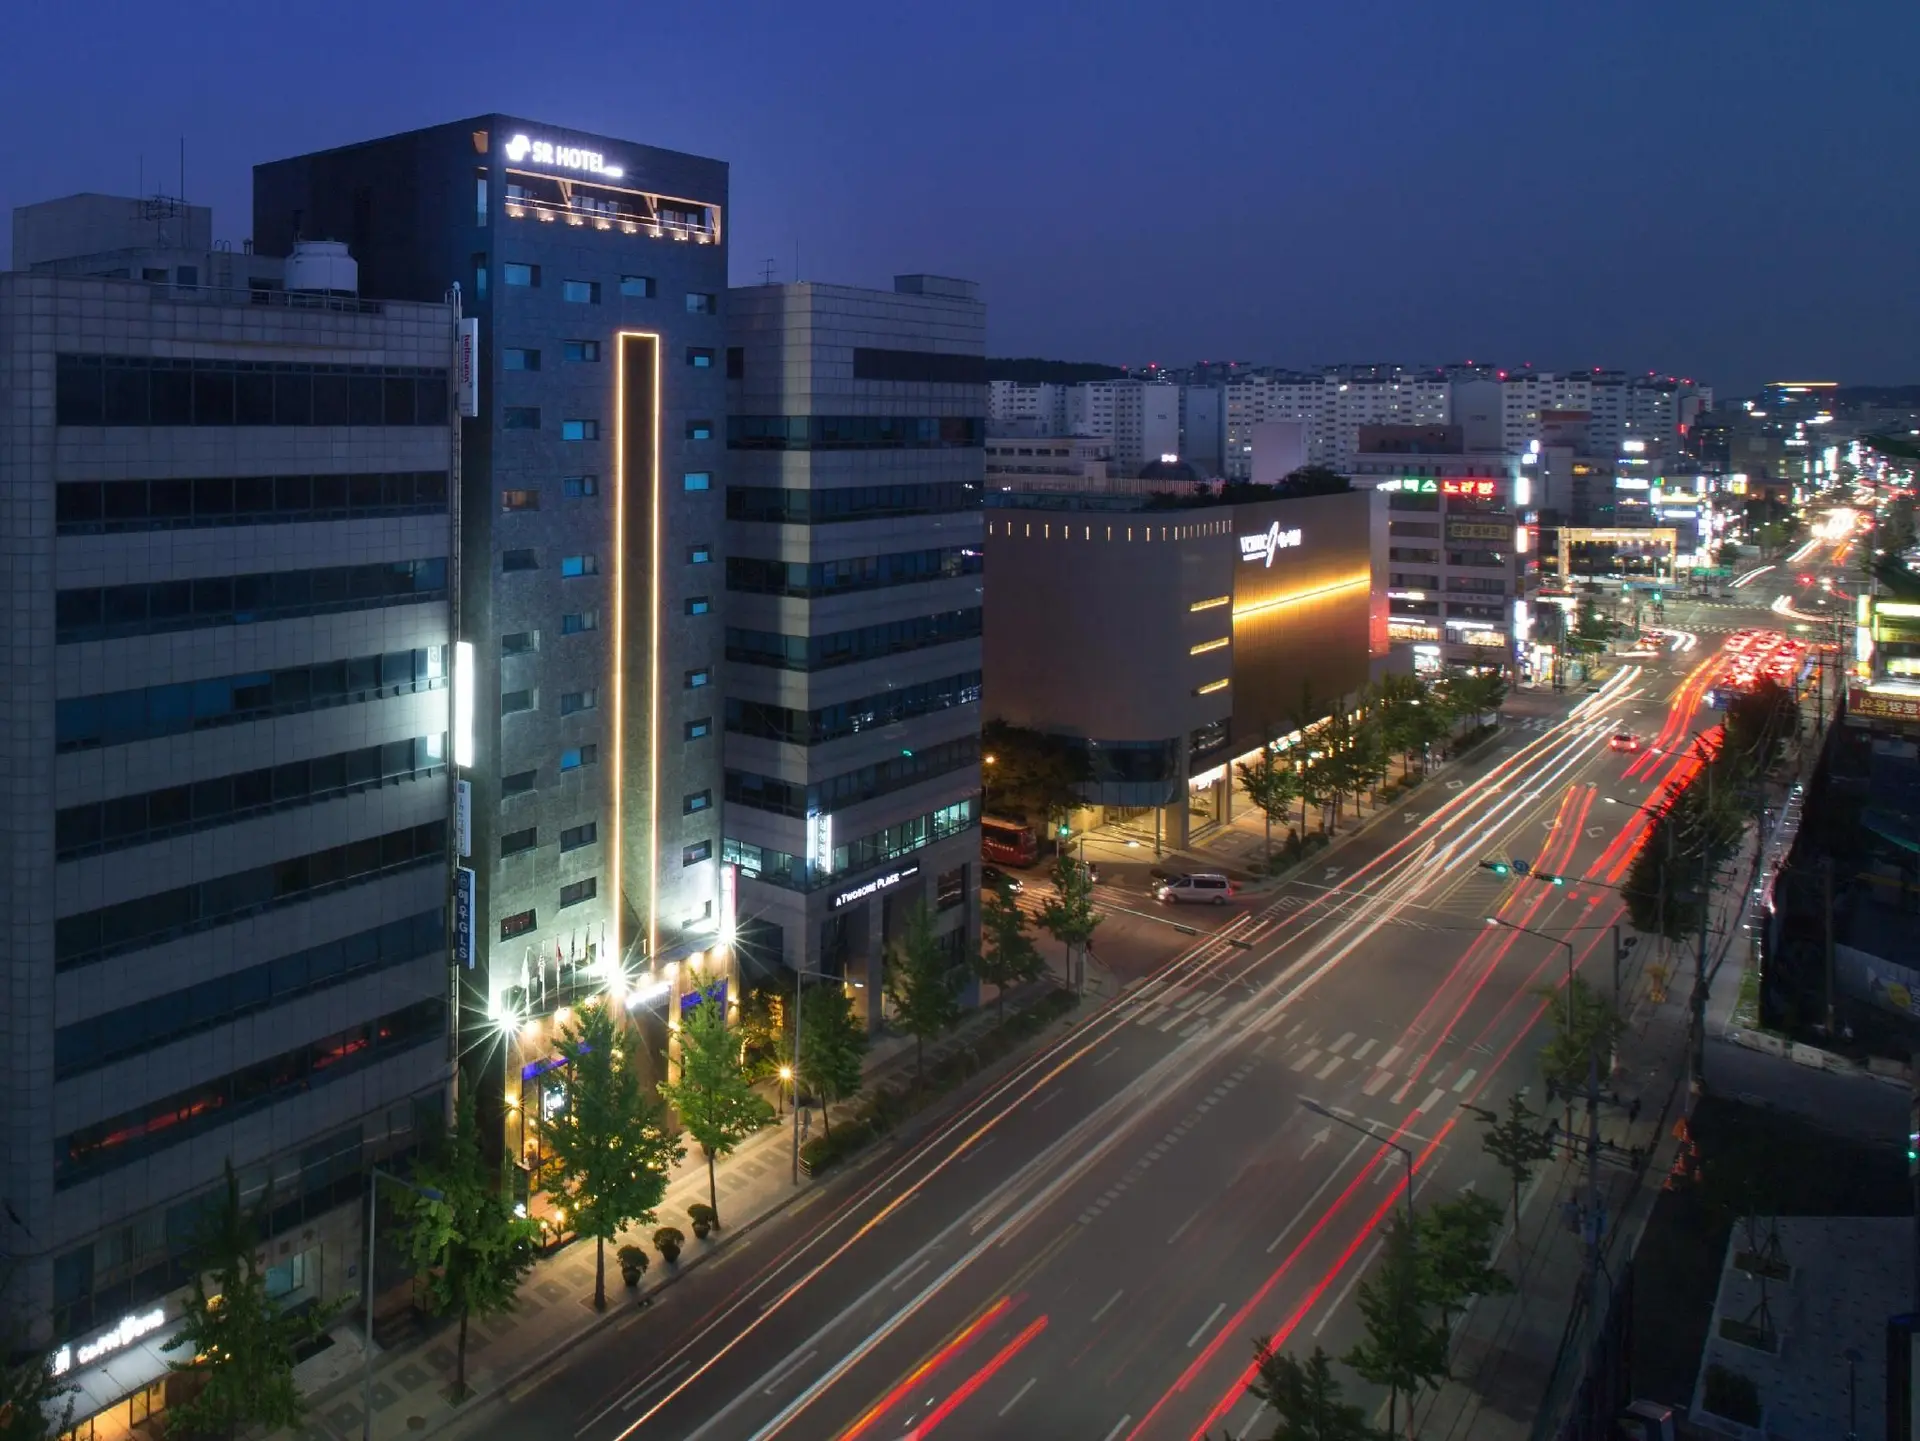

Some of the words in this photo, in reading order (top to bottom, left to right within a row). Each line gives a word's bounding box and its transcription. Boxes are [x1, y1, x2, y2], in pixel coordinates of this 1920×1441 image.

[533, 141, 553, 164] SR
[556, 145, 603, 172] HOTEL
[1443, 480, 1495, 494] 노래방
[877, 873, 900, 890] PLACE
